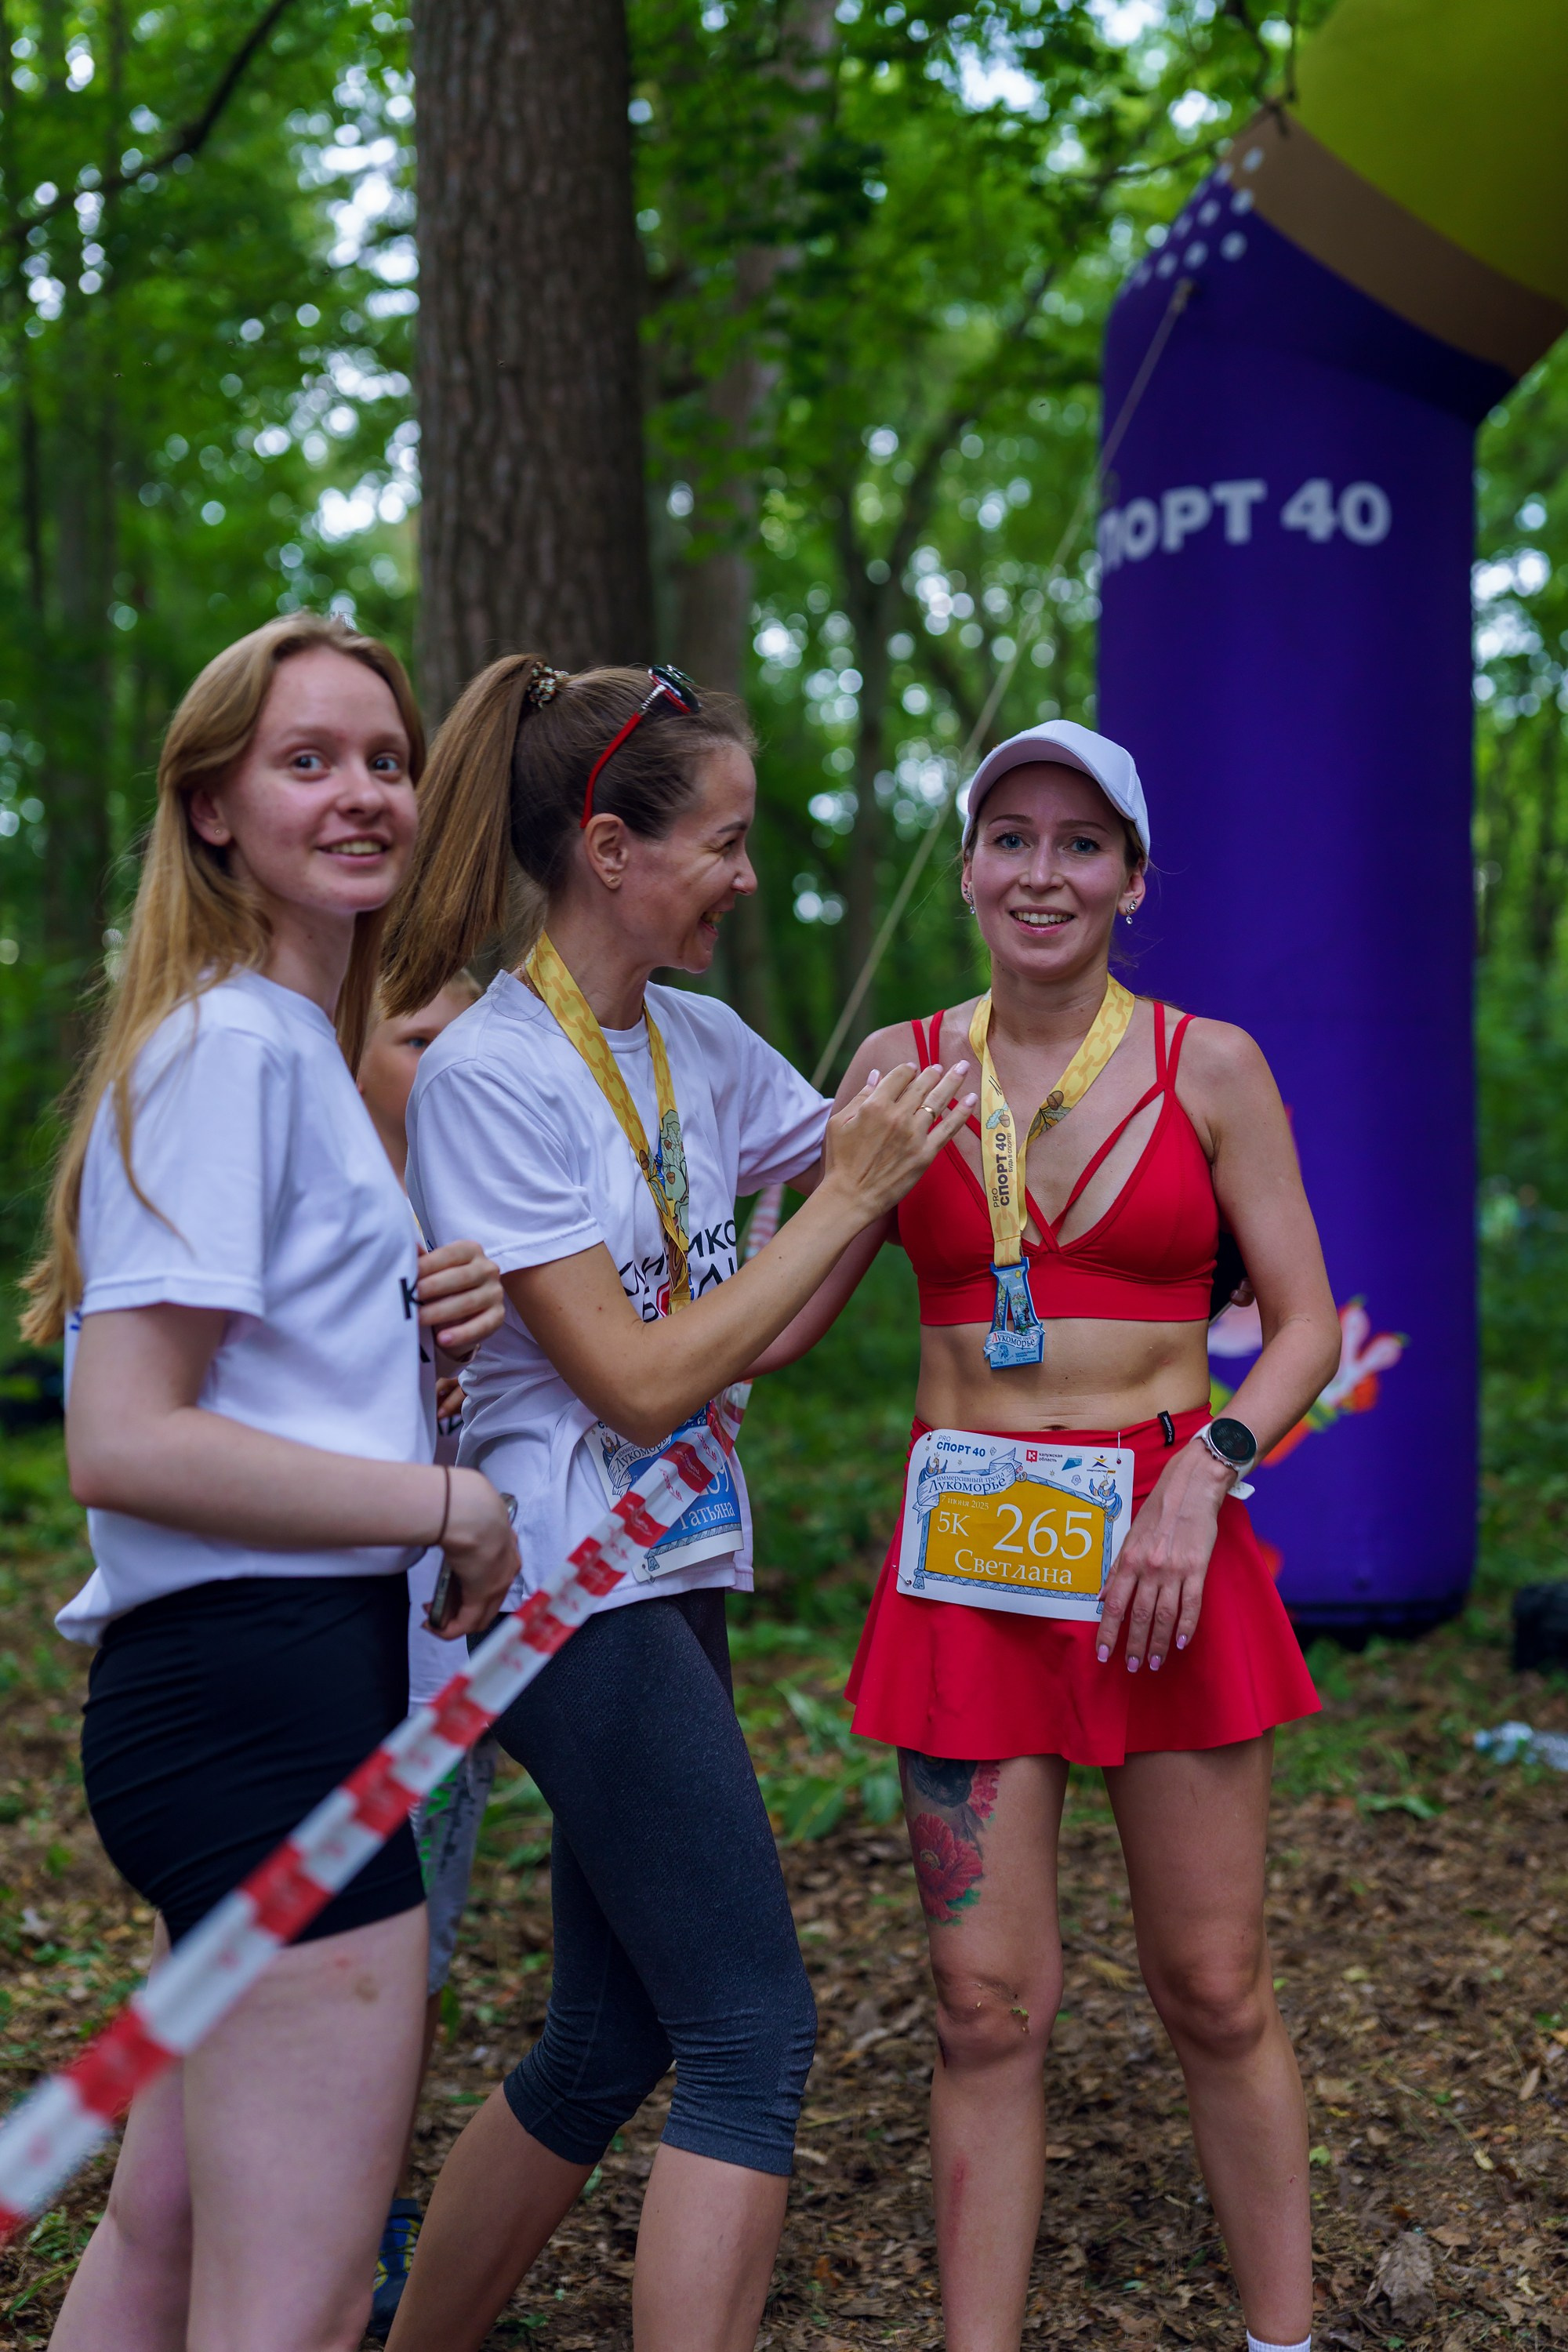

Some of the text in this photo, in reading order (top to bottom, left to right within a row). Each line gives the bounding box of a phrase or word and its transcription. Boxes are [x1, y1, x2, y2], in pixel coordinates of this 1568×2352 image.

[1279, 477, 1393, 546] 40
[996, 1133, 1010, 1206] СПОРТ 40
[992, 1333, 1035, 1349] Лукоморье
[937, 1442, 985, 1457] СПОРТ 40
[928, 1478, 1006, 1495] Лукоморье
[947, 1497, 970, 1507] июня
[971, 1500, 989, 1510] 2025
[993, 1504, 1092, 1559] 265
[954, 1548, 1073, 1585] Светлана
